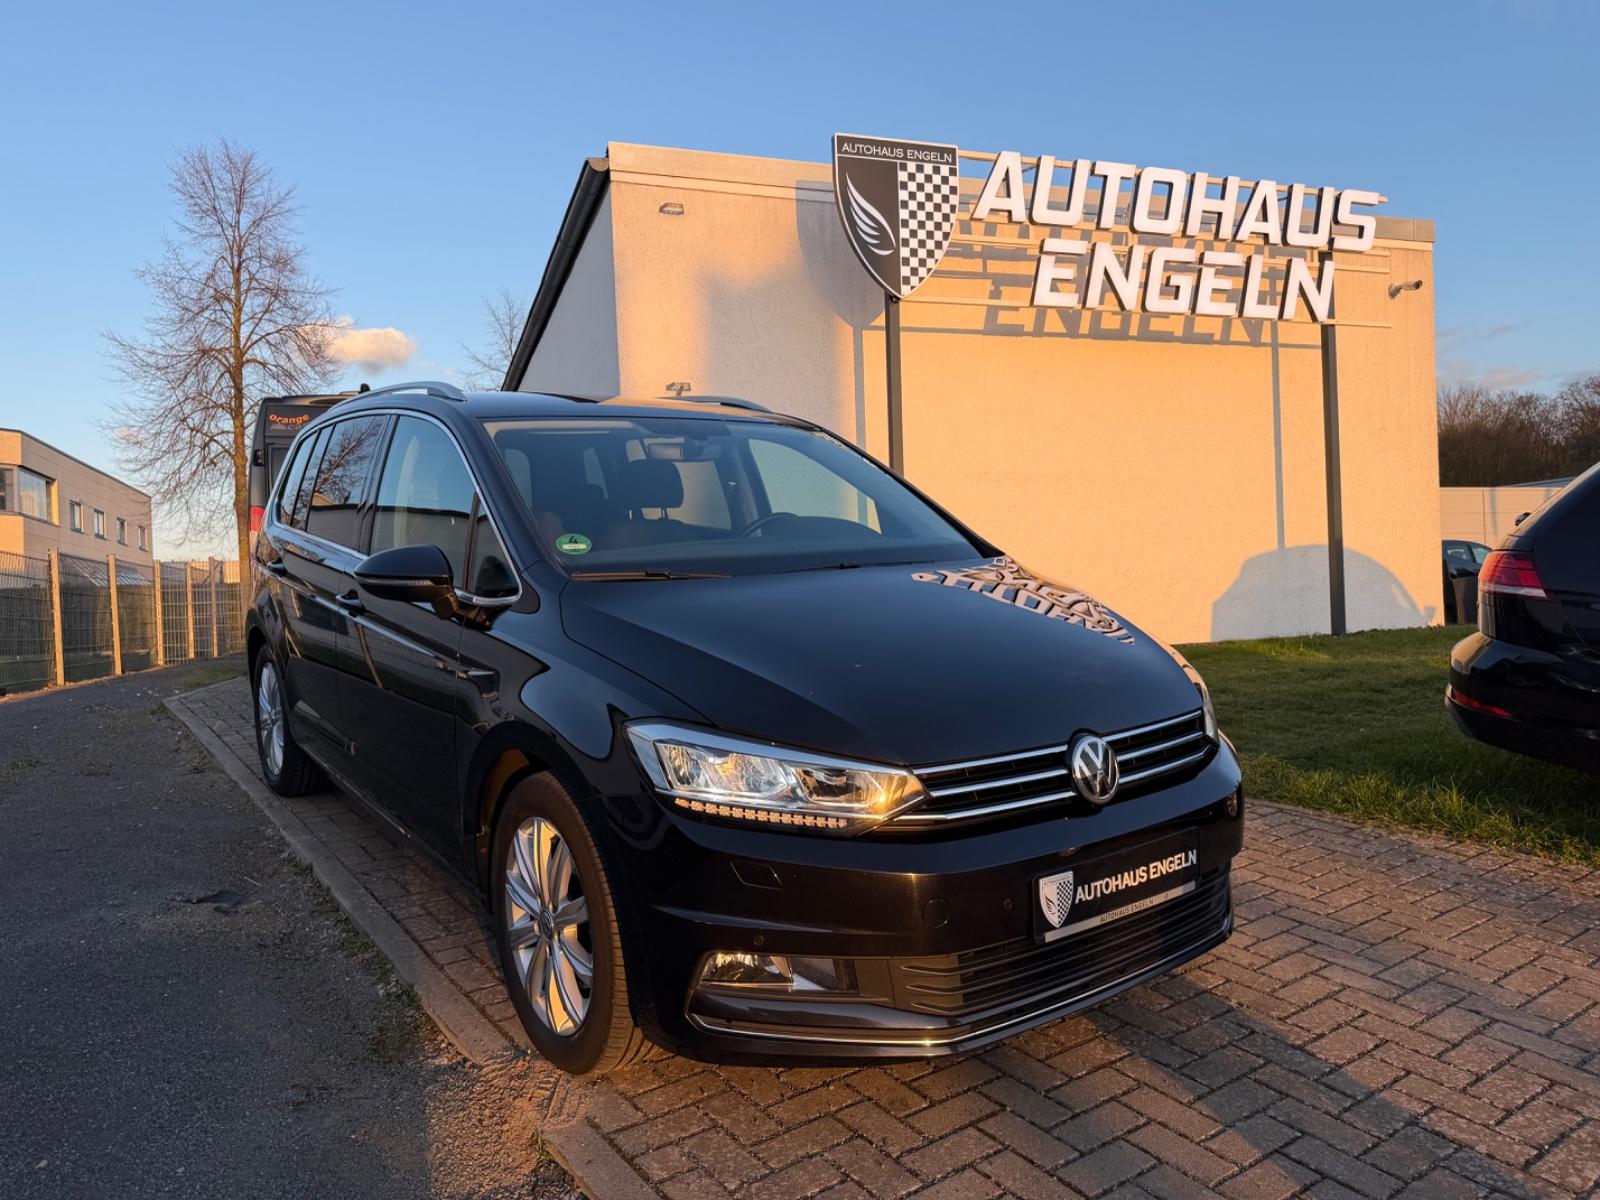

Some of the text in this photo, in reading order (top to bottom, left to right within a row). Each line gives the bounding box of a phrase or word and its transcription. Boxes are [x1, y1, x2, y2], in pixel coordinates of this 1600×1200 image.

[842, 142, 952, 163] AUTOHAUS ENGELN
[971, 150, 1379, 253] AUTOHAUS
[1032, 237, 1335, 322] ENGELN
[269, 414, 310, 424] orange
[1075, 849, 1197, 904] AUTOHAUS ENGELN
